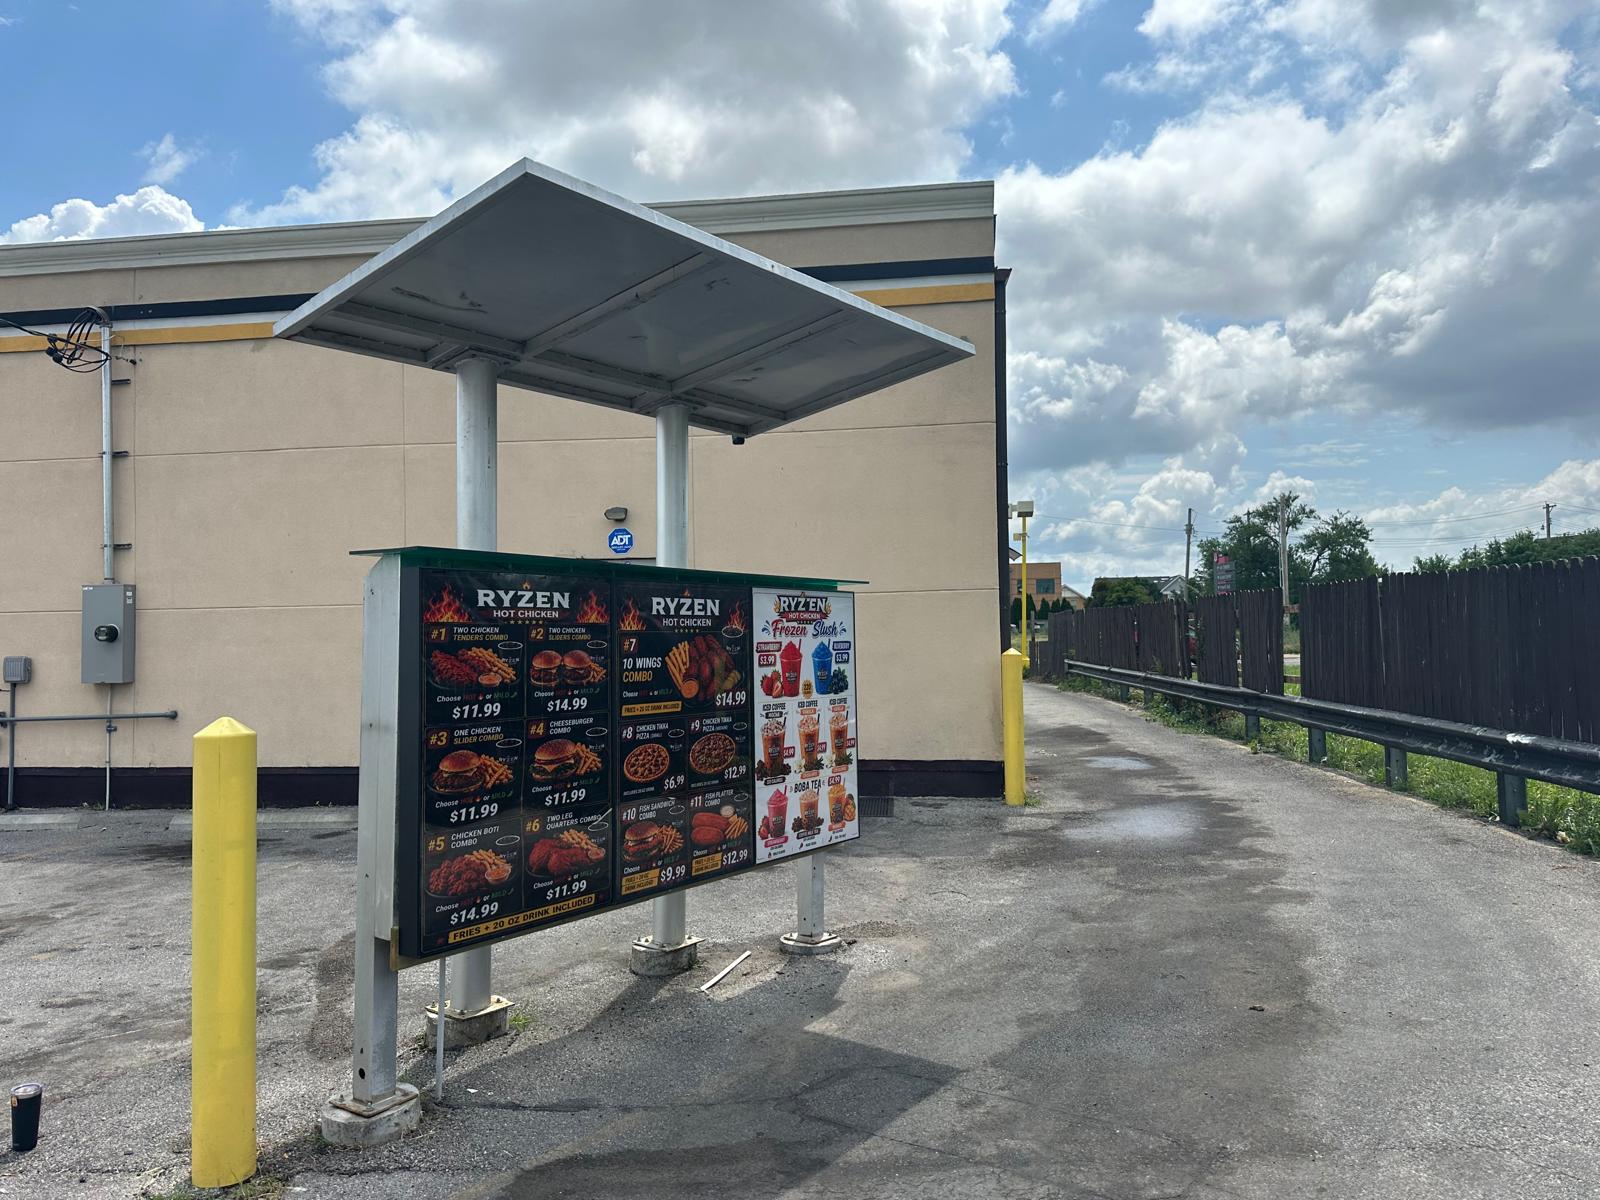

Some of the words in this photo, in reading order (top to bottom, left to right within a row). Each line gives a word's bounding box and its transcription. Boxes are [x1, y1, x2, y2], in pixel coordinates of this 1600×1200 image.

[611, 535, 631, 546] ADT
[476, 589, 570, 609] RYZEN
[779, 596, 827, 612] RYZEN
[651, 597, 720, 616] RYZEN
[493, 610, 516, 618] HOT
[518, 610, 559, 618] CHICKEN
[662, 618, 678, 626] HOT
[679, 618, 712, 627] CHICKEN
[771, 618, 808, 638] Frozen
[812, 619, 839, 638] Slush
[431, 628, 446, 641] #1
[530, 627, 544, 640] #2
[623, 638, 637, 652] #7
[623, 658, 633, 669] 10
[635, 657, 662, 669] WINGS
[760, 655, 775, 665] $3.99
[836, 653, 848, 662] $3.99
[622, 670, 653, 683] COMBO
[436, 695, 462, 703] Choose
[546, 697, 588, 712] $14.99
[715, 691, 746, 706] $14.99
[452, 702, 501, 720] $11.99
[771, 703, 786, 711] COFFEE
[530, 722, 544, 735] #4
[549, 717, 594, 728] CHEESEBURGER
[636, 724, 656, 732] CHICKEN
[690, 719, 700, 731] #9
[454, 728, 469, 737] ONE
[470, 726, 502, 735] CHICKEN
[549, 726, 572, 735] COMBO
[622, 726, 633, 739] #8
[429, 731, 448, 746] #3
[453, 735, 478, 745] SLIDER
[478, 733, 504, 742] COMBO
[783, 748, 795, 757] $4.99
[724, 765, 747, 780] $12.99
[531, 785, 553, 793] Choose
[664, 774, 685, 791] $6.99
[794, 782, 810, 793] BOBA
[811, 779, 822, 789] TEA
[544, 788, 586, 806] $11.99
[690, 795, 702, 807] #11
[704, 792, 716, 800] FISH
[715, 789, 734, 798] PLATTER
[435, 800, 459, 809] Choose
[639, 804, 650, 813] FISH
[651, 800, 676, 810] SANDWICH
[704, 799, 720, 807] COMBO
[449, 802, 499, 823] $11.99
[546, 814, 560, 823] TWO
[561, 812, 573, 820] LEG
[622, 807, 636, 820] #10
[639, 811, 657, 820] COMBO
[525, 818, 540, 832] #6
[546, 818, 579, 831] QUARTERS
[579, 814, 601, 824] COMBO
[451, 828, 482, 841] CHICKEN
[483, 825, 500, 835] BOTI
[428, 836, 445, 851] #5
[451, 838, 478, 849] COMBO
[722, 848, 748, 866] $12.99
[660, 864, 686, 882] $9.99
[533, 880, 554, 889] Choose
[546, 879, 587, 901] $11.99
[435, 902, 459, 913] Choose
[449, 901, 499, 925] $14.99
[453, 926, 481, 940] FRIES
[493, 920, 505, 929] 20
[507, 916, 520, 926] OZ
[522, 907, 550, 921] DRINK
[552, 895, 594, 913] INCLUDED
